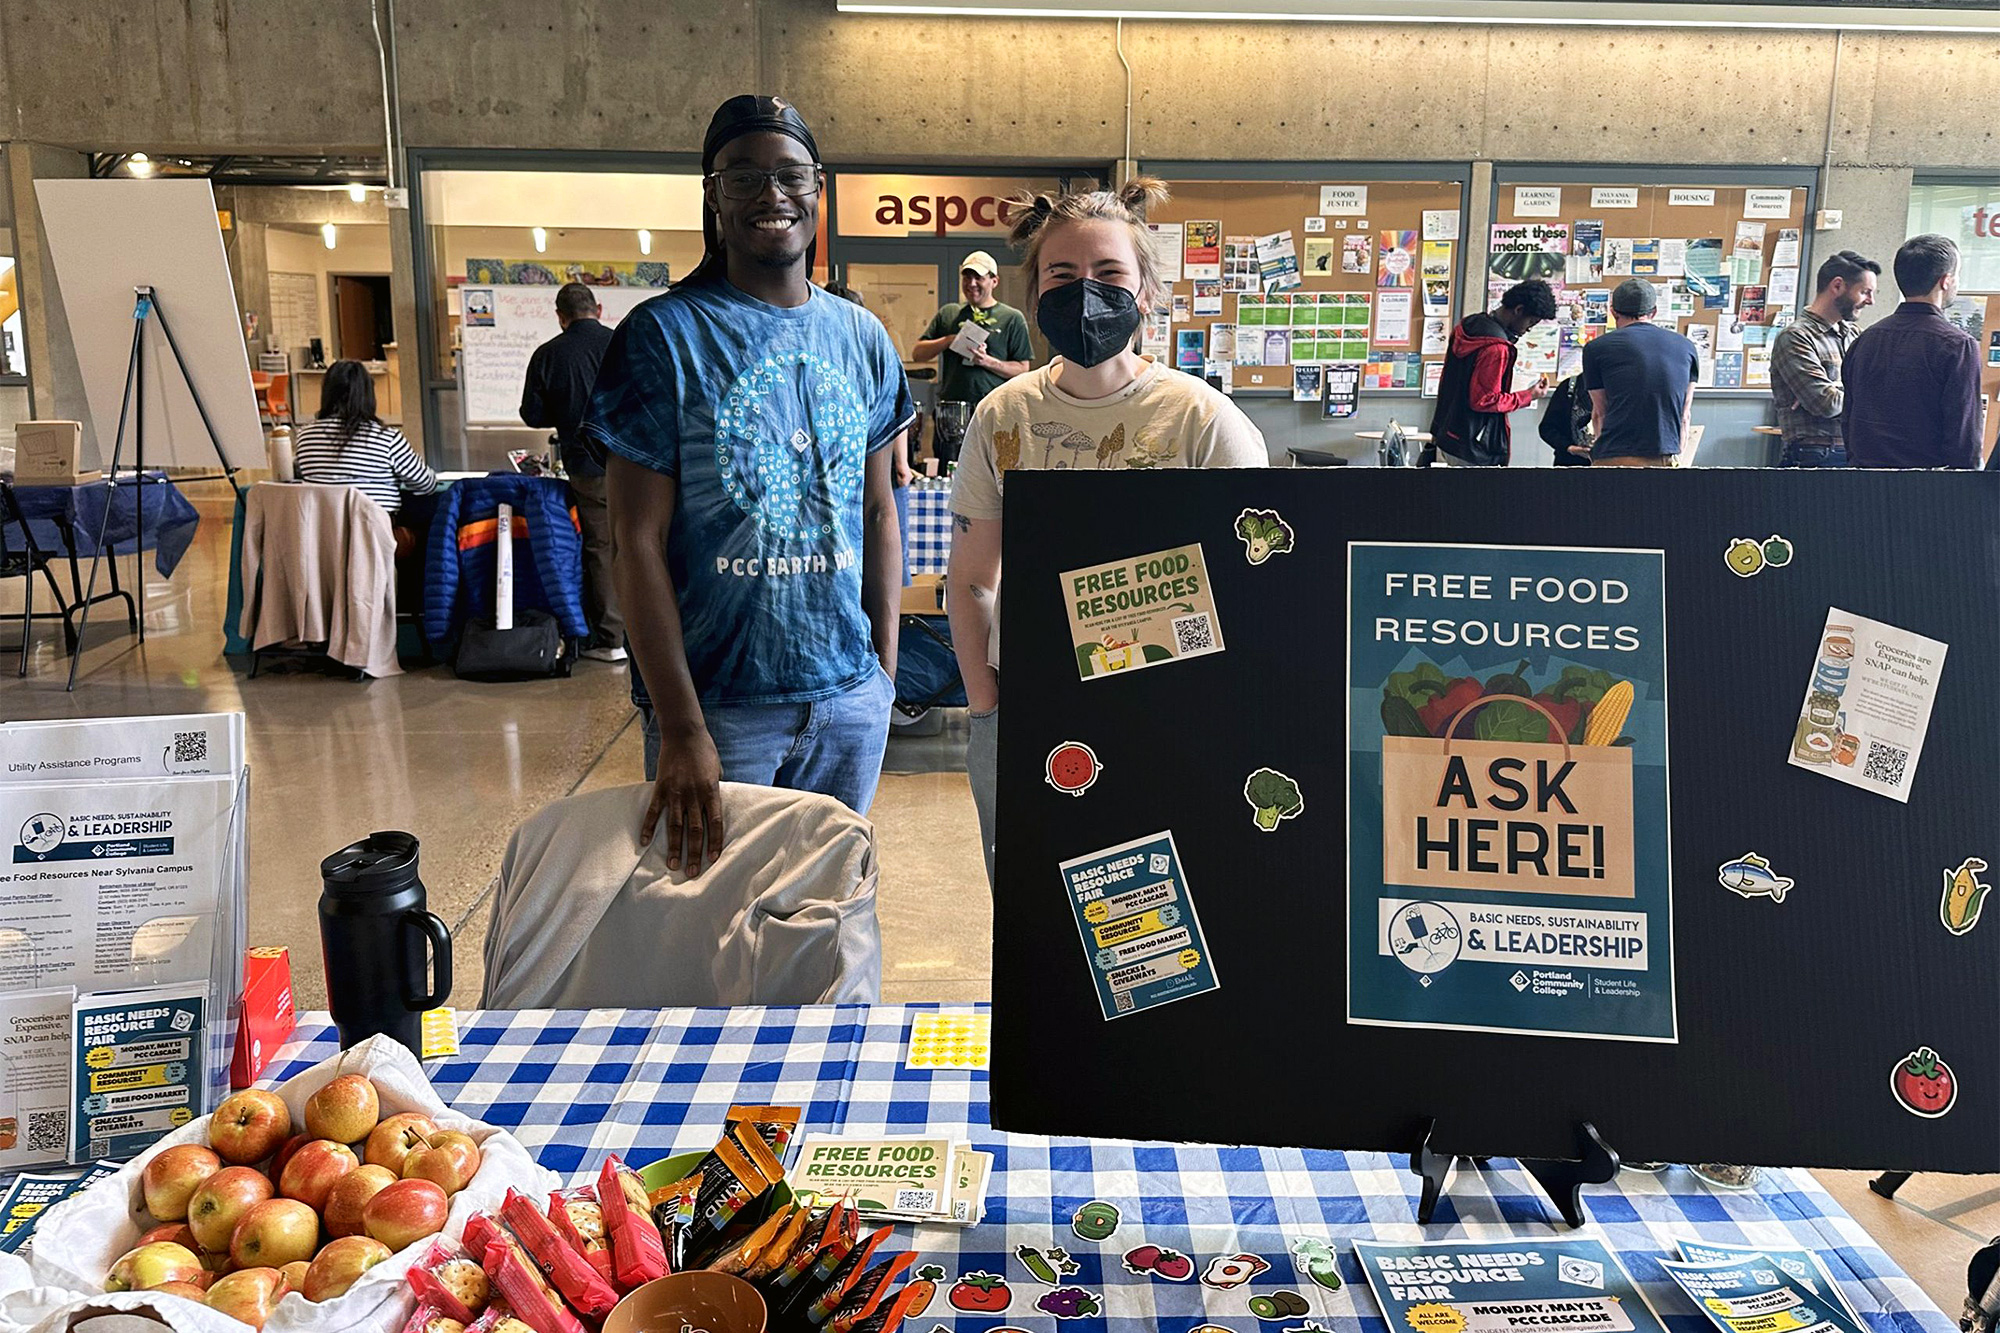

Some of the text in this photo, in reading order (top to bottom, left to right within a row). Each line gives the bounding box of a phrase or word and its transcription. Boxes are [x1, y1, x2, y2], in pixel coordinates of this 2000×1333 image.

[1326, 200, 1360, 208] JUSTICE
[1750, 194, 1786, 202] Community
[1494, 226, 1567, 238] meet these
[1493, 239, 1544, 252] melons.
[716, 557, 758, 577] PCC
[768, 555, 826, 576] EARTH
[1074, 554, 1189, 596] FREE FOOD
[1386, 573, 1629, 604] FREE FOOD
[1076, 576, 1200, 620] RESOURCES
[1375, 618, 1640, 651] RESOURCES
[1874, 640, 1932, 666] Groceries are
[1878, 650, 1923, 671] Expensive.
[1864, 658, 1930, 686] SNAP can help.
[8, 755, 141, 773] Utility Assistance Programs
[1436, 756, 1578, 814] ASK
[118, 811, 171, 820] SUSTAINABILITY
[68, 820, 172, 837] & LEADERSHIP
[1416, 816, 1605, 879] HERE!
[14, 873, 37, 882] Food
[40, 870, 88, 880] Resources
[92, 868, 113, 878] Near
[116, 866, 154, 877] Sylvania
[156, 864, 193, 876] Campus
[1071, 854, 1145, 884] BASIC NEEDS
[1074, 868, 1135, 893] RESOURCE
[1076, 888, 1104, 904] FAIR
[1111, 892, 1144, 905] MONDAY,
[1144, 887, 1159, 895] MAY
[1125, 891, 1169, 908] PCC CASCADE
[1099, 916, 1143, 934] COMMUNITY
[1470, 912, 1640, 931] BASIC NEEDS, SUSTAINABILITY
[1100, 924, 1141, 941] RESOURCES
[1118, 930, 1187, 956] FREE FOOD MARKET
[1467, 929, 1643, 960] & LEADERSHIP
[1110, 966, 1140, 979] SNACKS
[1113, 969, 1156, 986] GIVEAWAYS
[1532, 970, 1572, 980] Portland
[1532, 978, 1584, 990] Community
[1594, 978, 1637, 988] Student Life
[1532, 986, 1568, 997] College
[1602, 988, 1641, 998] Leadership
[10, 1014, 54, 1024] Groceries
[84, 1008, 170, 1026] BASIC NEEDS
[16, 1022, 62, 1033] Expensive.
[84, 1020, 155, 1036] RESOURCE
[4, 1035, 32, 1045] SNAP
[51, 1032, 72, 1042] help.
[84, 1035, 116, 1047] FAIR
[149, 1049, 181, 1057] CASCADE
[97, 1069, 148, 1080] COMMUNITY
[97, 1076, 142, 1086] RESOURCES
[154, 1090, 187, 1099] MARKET
[94, 1120, 144, 1132] GIVEAWAYS
[95, 1116, 128, 1125] SNACKS
[812, 1147, 934, 1161] FREE FOOD
[806, 1164, 936, 1178] RESOURCES
[24, 1182, 67, 1190] BASIC
[706, 1182, 744, 1218] KIND
[664, 1193, 682, 1225] IND
[1375, 1252, 1545, 1271] BASIC NEEDS
[1382, 1268, 1524, 1286] RESOURCE
[1674, 1270, 1746, 1282] BASIC NEEDS
[1682, 1280, 1743, 1290] RESOURCE
[1389, 1286, 1455, 1301] FAIR
[1690, 1290, 1719, 1298] FAIR
[1474, 1302, 1604, 1315] MONDAY, MAY 13
[1510, 1313, 1612, 1326] PCC CASCADE
[1732, 1317, 1776, 1326] COMMUNITY
